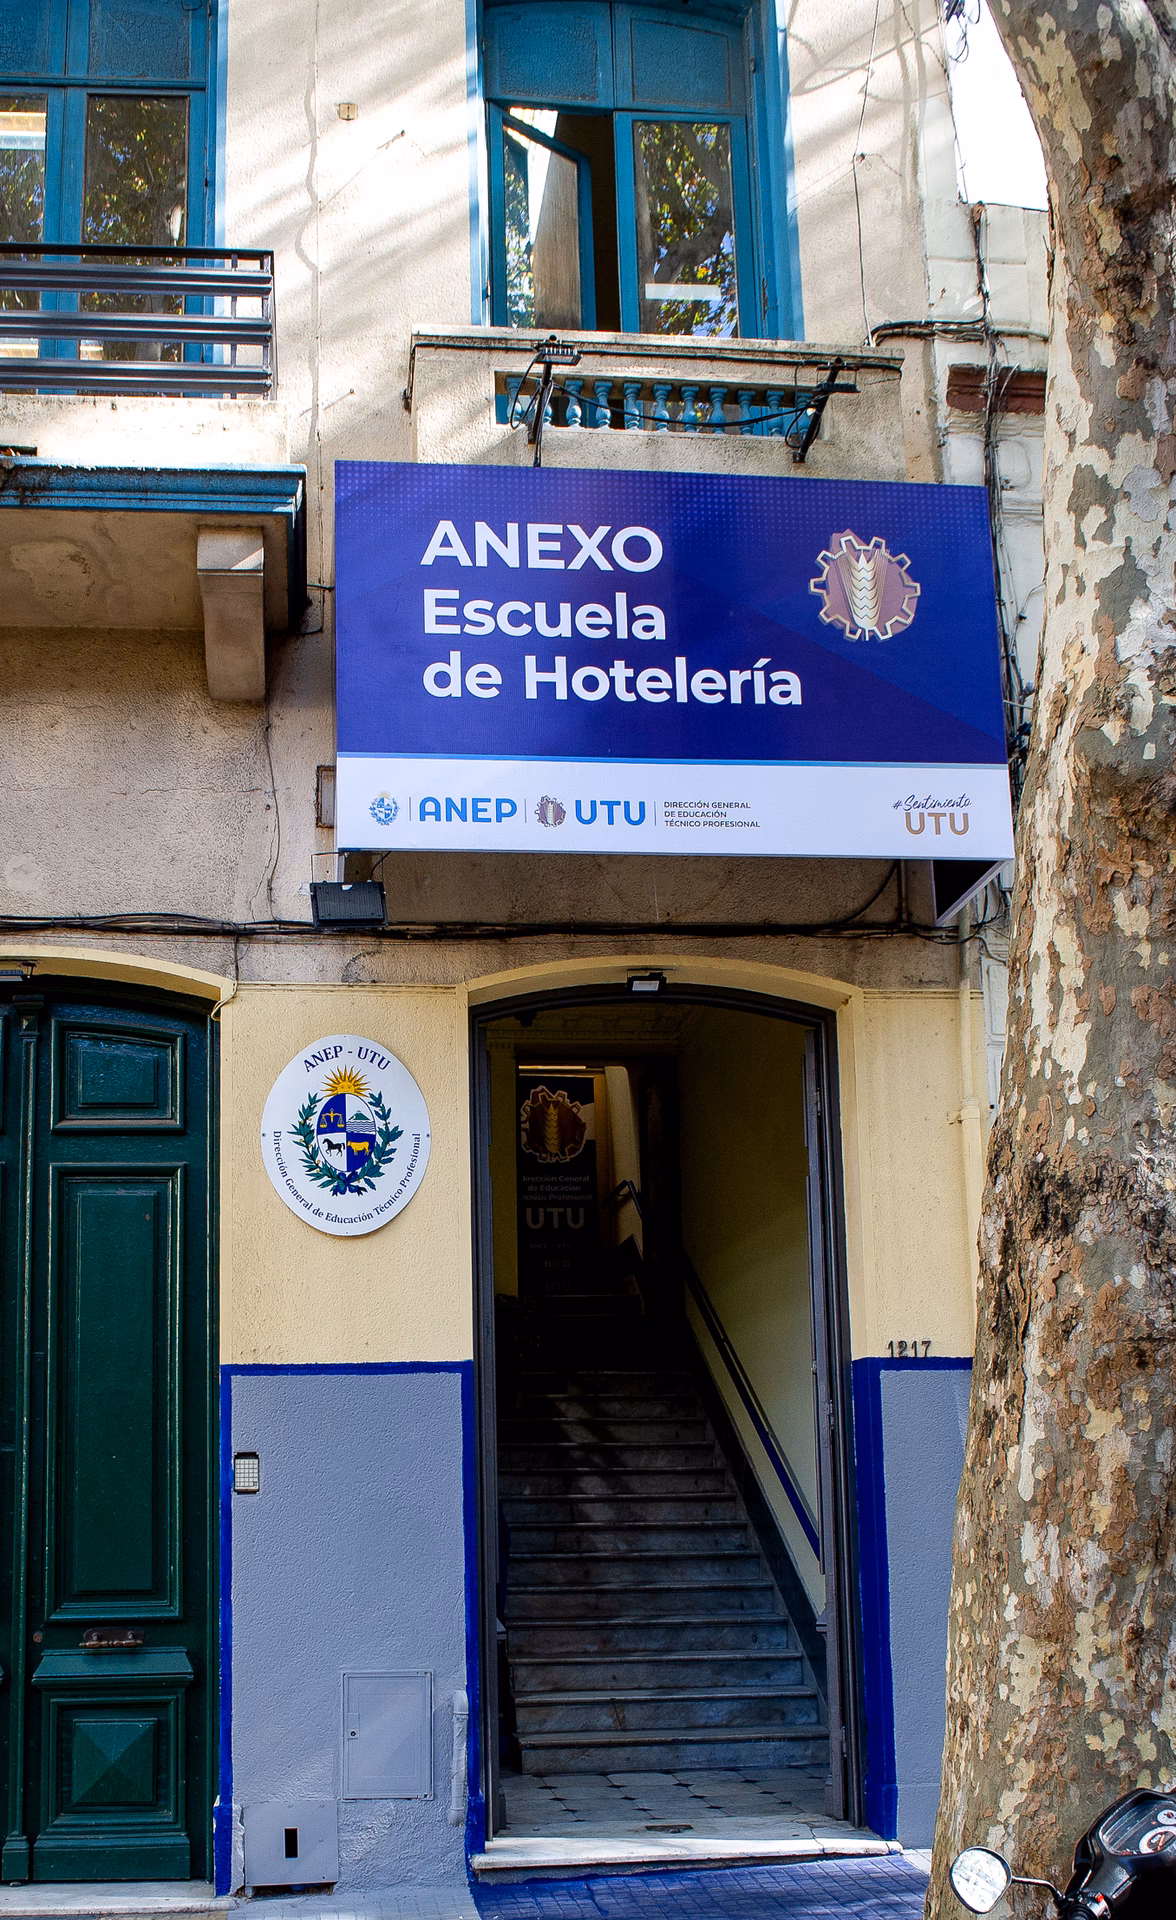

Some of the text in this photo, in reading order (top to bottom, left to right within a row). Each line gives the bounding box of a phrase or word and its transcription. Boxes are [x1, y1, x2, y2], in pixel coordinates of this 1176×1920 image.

[420, 520, 663, 572] ANEXO
[423, 588, 666, 640] Escuela
[422, 651, 802, 705] de Hotelería
[419, 796, 517, 823] ANEP
[574, 799, 646, 826] UTU
[664, 800, 751, 809] DIRECCIÓN GENERAL
[677, 810, 727, 818] EDUCACIÓN
[892, 793, 972, 811] #Sentimiento
[664, 819, 761, 828] TÉCNICO PROFESIONAL
[905, 812, 969, 836] UTU
[303, 1045, 343, 1073] ANEP
[357, 1046, 391, 1071] UTU
[273, 1130, 421, 1224] Dirección General de Educación Técnico Profesional
[558, 1174, 590, 1183] General
[526, 1207, 585, 1229] UTU
[886, 1340, 932, 1358] 1217
